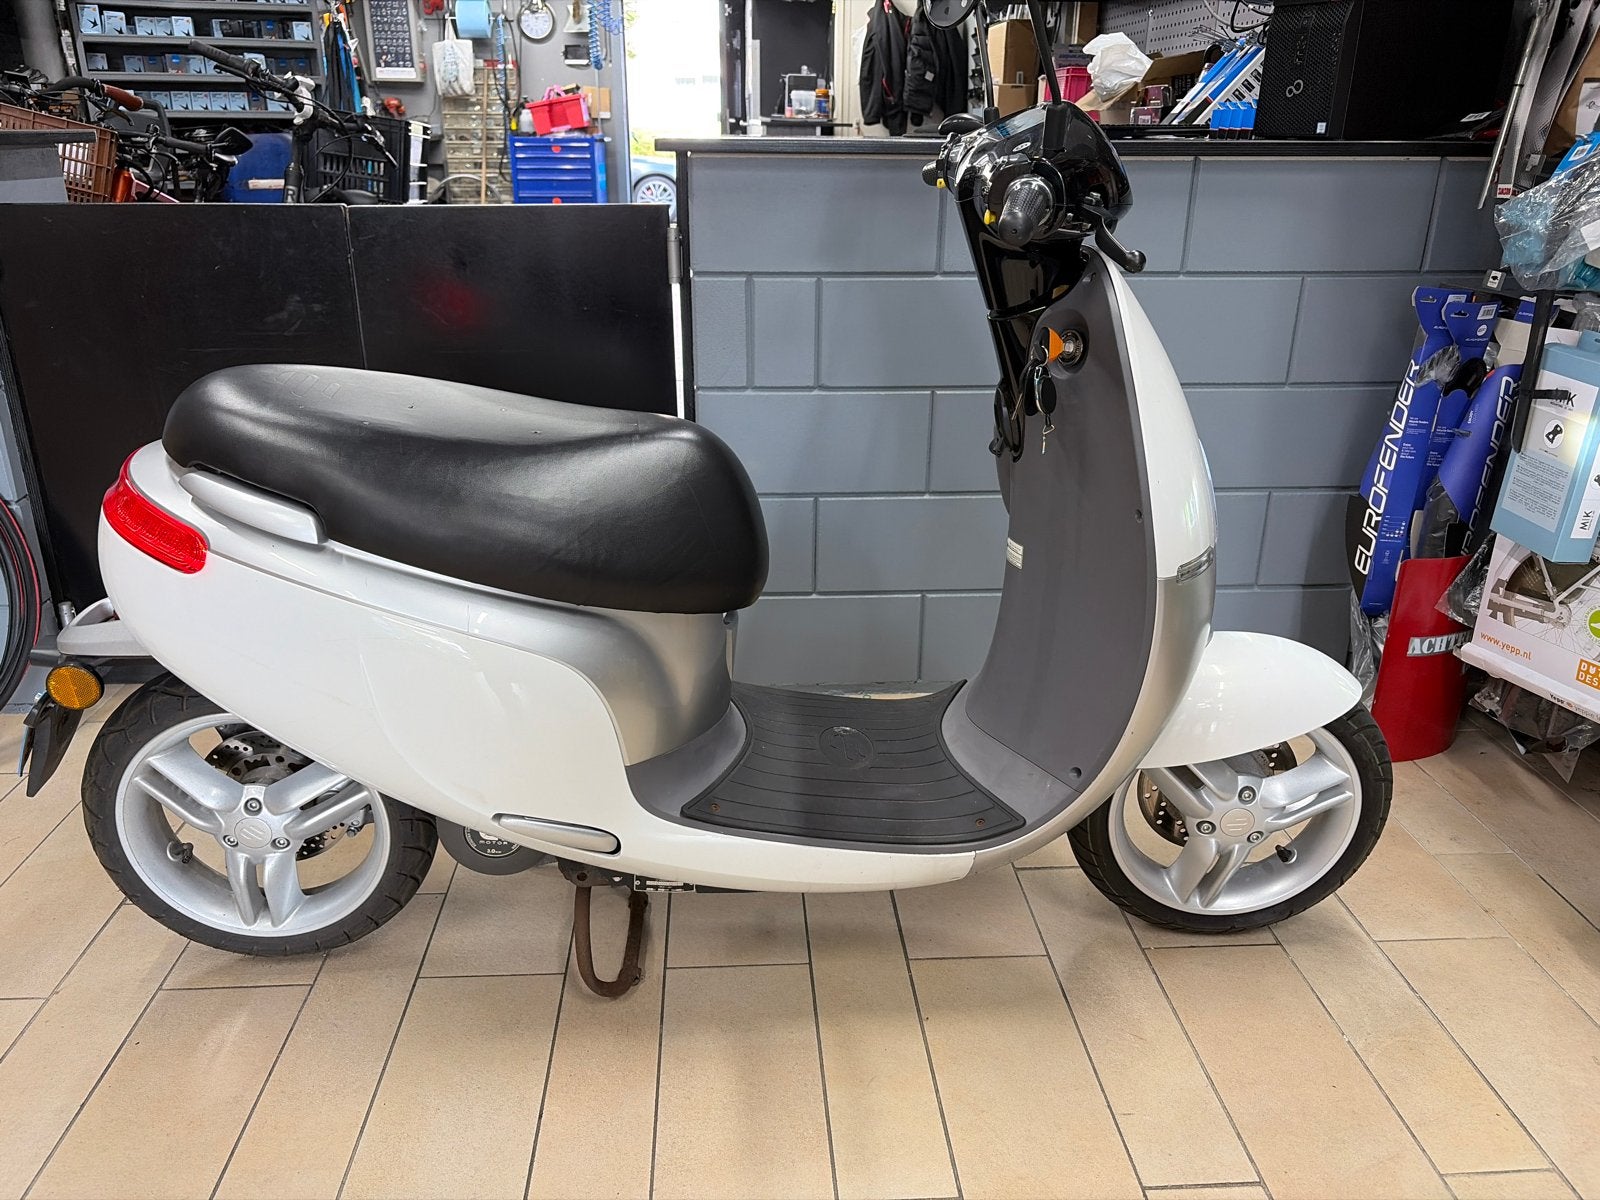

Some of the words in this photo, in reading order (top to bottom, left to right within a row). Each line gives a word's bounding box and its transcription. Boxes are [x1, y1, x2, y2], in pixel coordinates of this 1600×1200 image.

[1354, 359, 1419, 575] EUROFENDER
[1480, 631, 1532, 661] www.yepp.nl
[1578, 671, 1600, 687] DES
